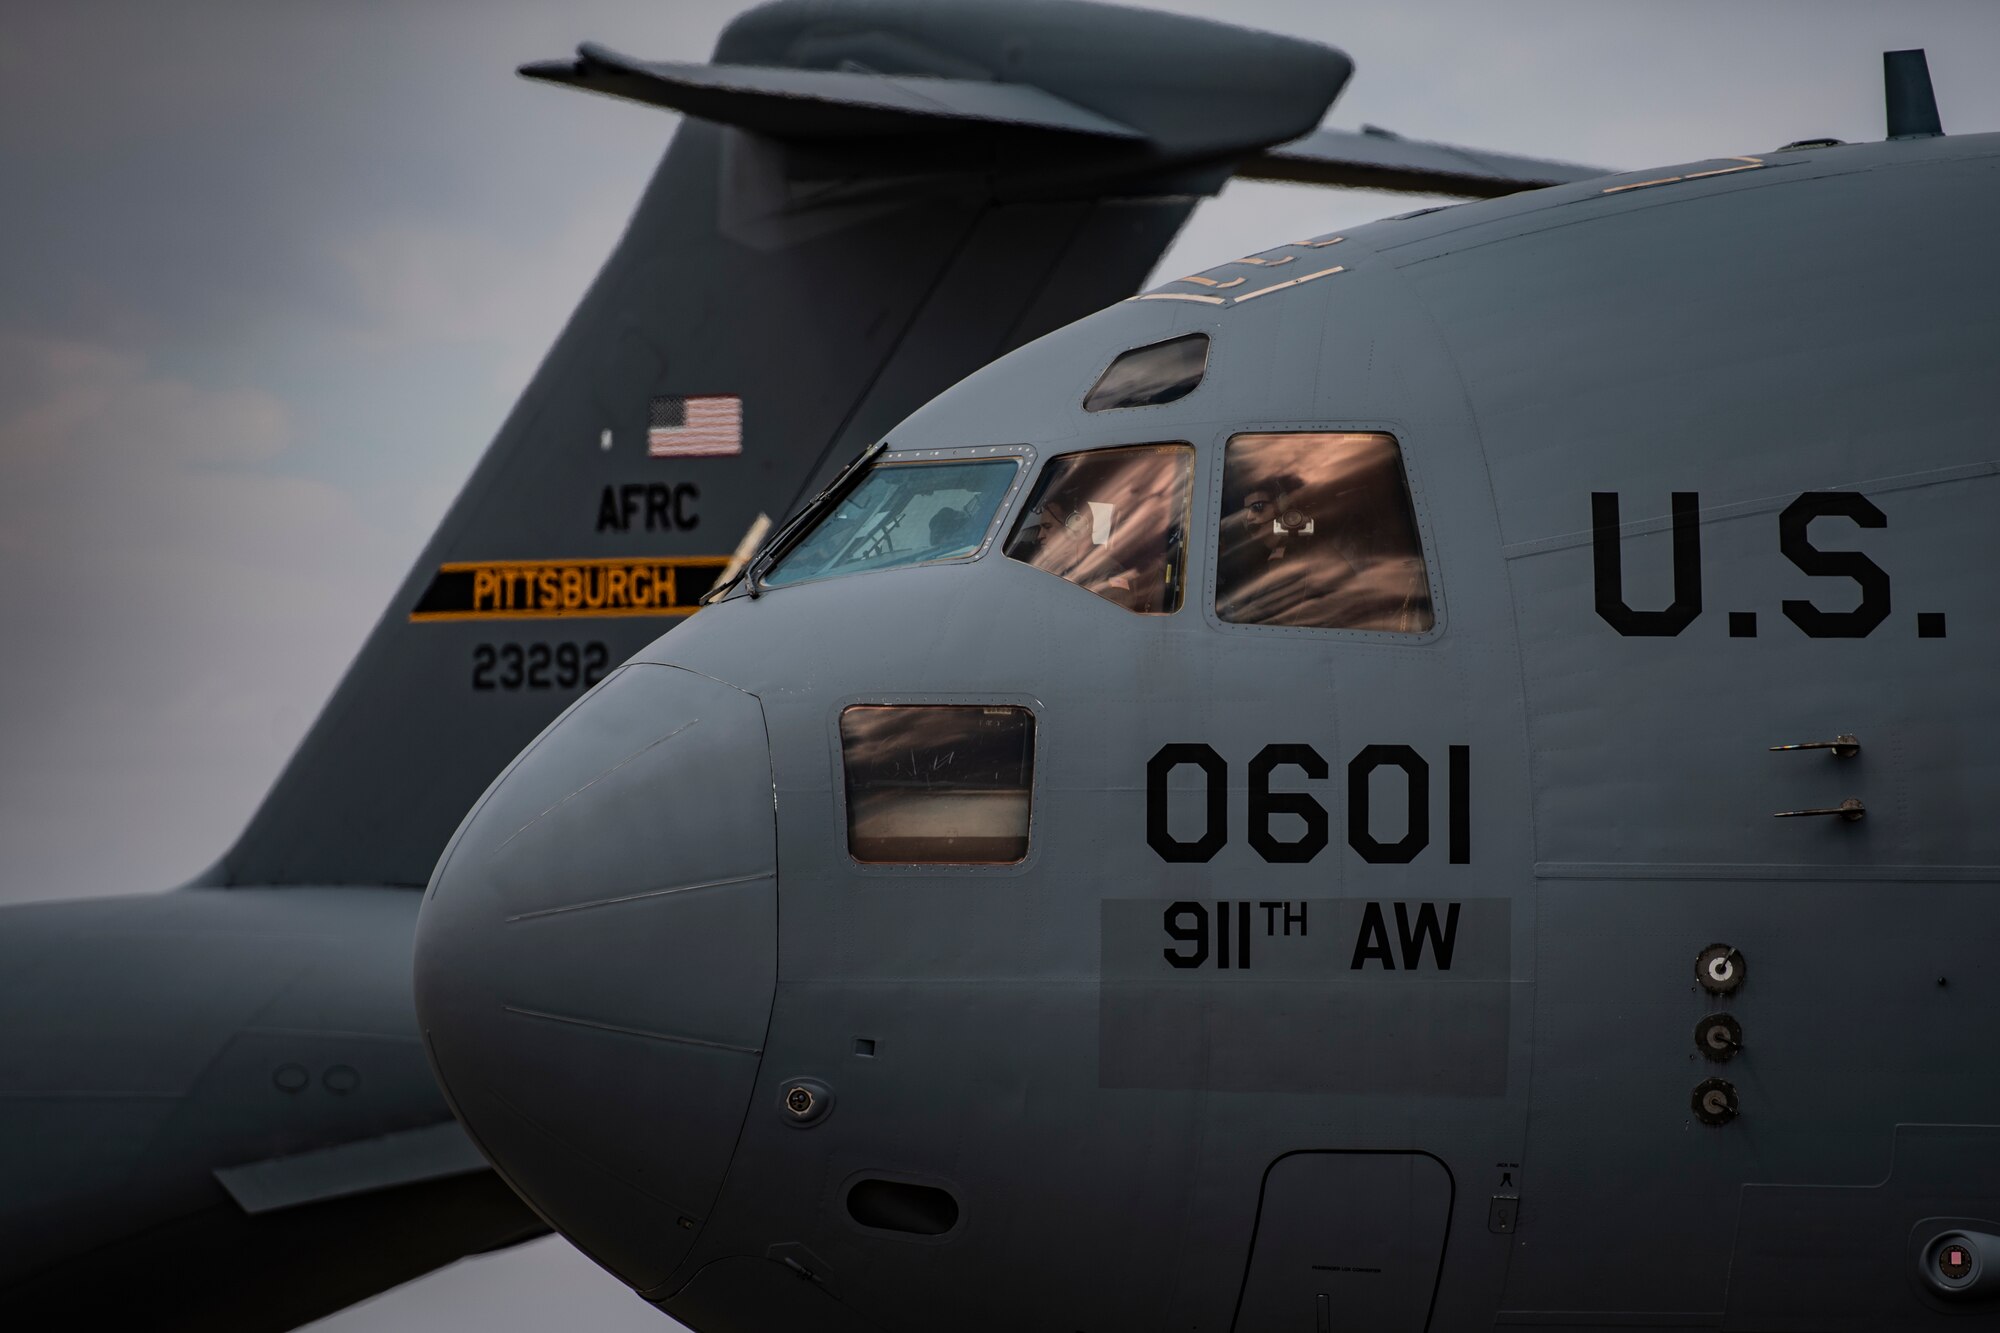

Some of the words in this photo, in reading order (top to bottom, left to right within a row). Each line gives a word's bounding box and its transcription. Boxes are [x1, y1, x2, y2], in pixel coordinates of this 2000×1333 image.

[597, 483, 699, 533] AFRC
[472, 566, 677, 610] PITTSBURGH
[1591, 491, 1946, 638] U.S.
[472, 640, 608, 690] 23292
[1146, 743, 1470, 864] 0601
[1350, 902, 1461, 970] AW
